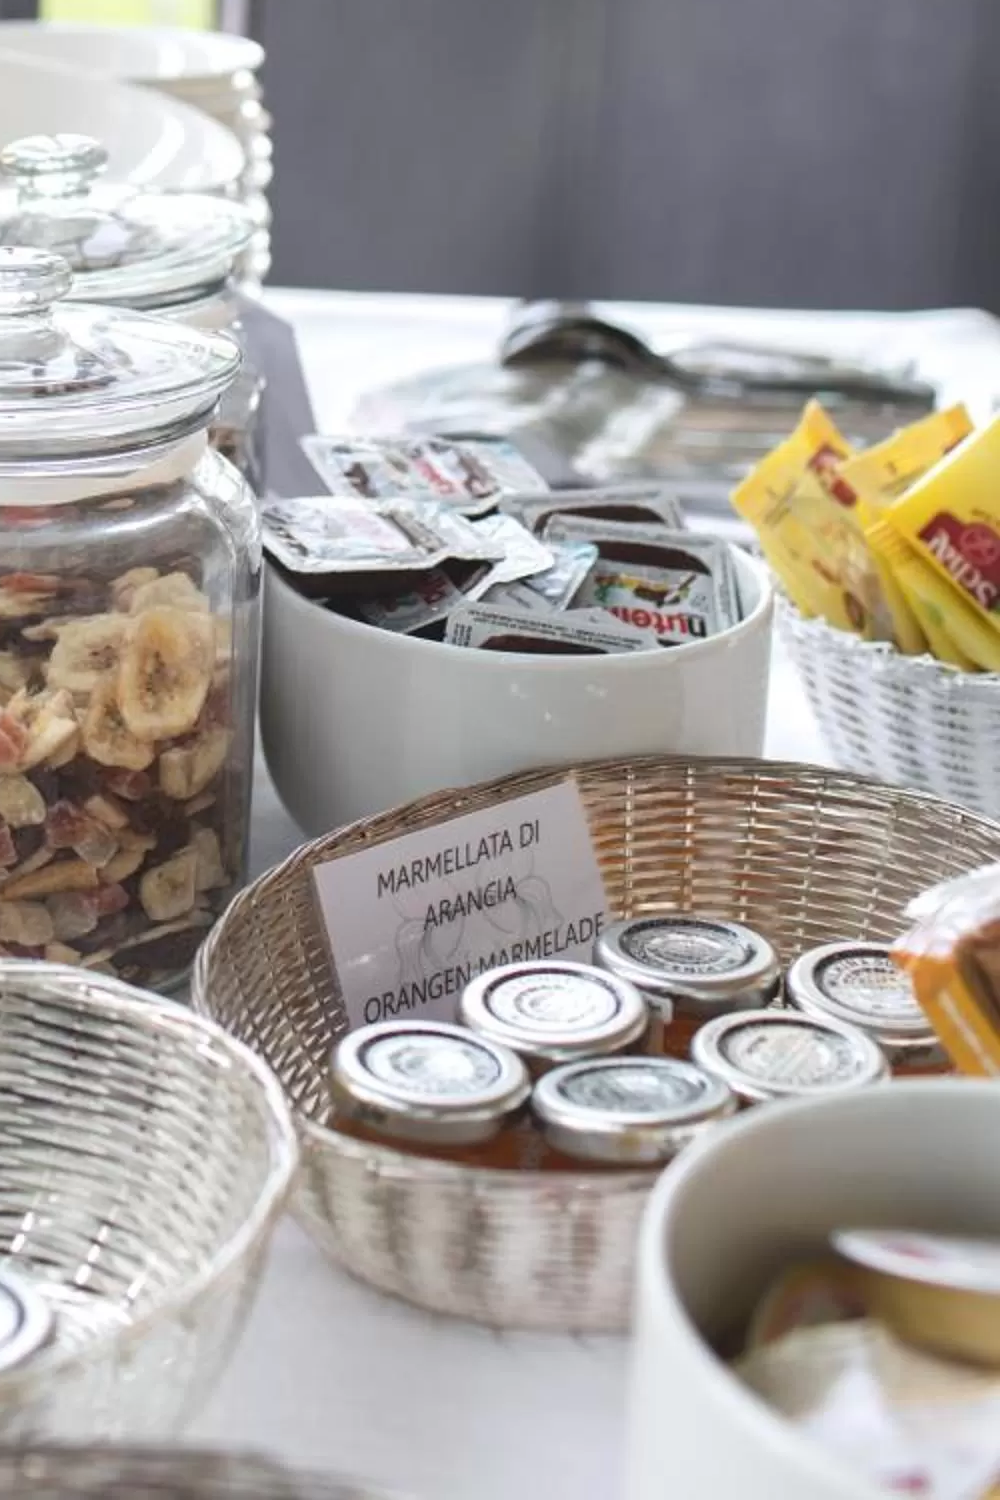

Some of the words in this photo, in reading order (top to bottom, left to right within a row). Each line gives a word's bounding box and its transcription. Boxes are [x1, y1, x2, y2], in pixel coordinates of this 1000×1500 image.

[377, 829, 514, 898] MARMELLATA
[519, 820, 540, 849] DI
[423, 876, 518, 932] ARANCIA
